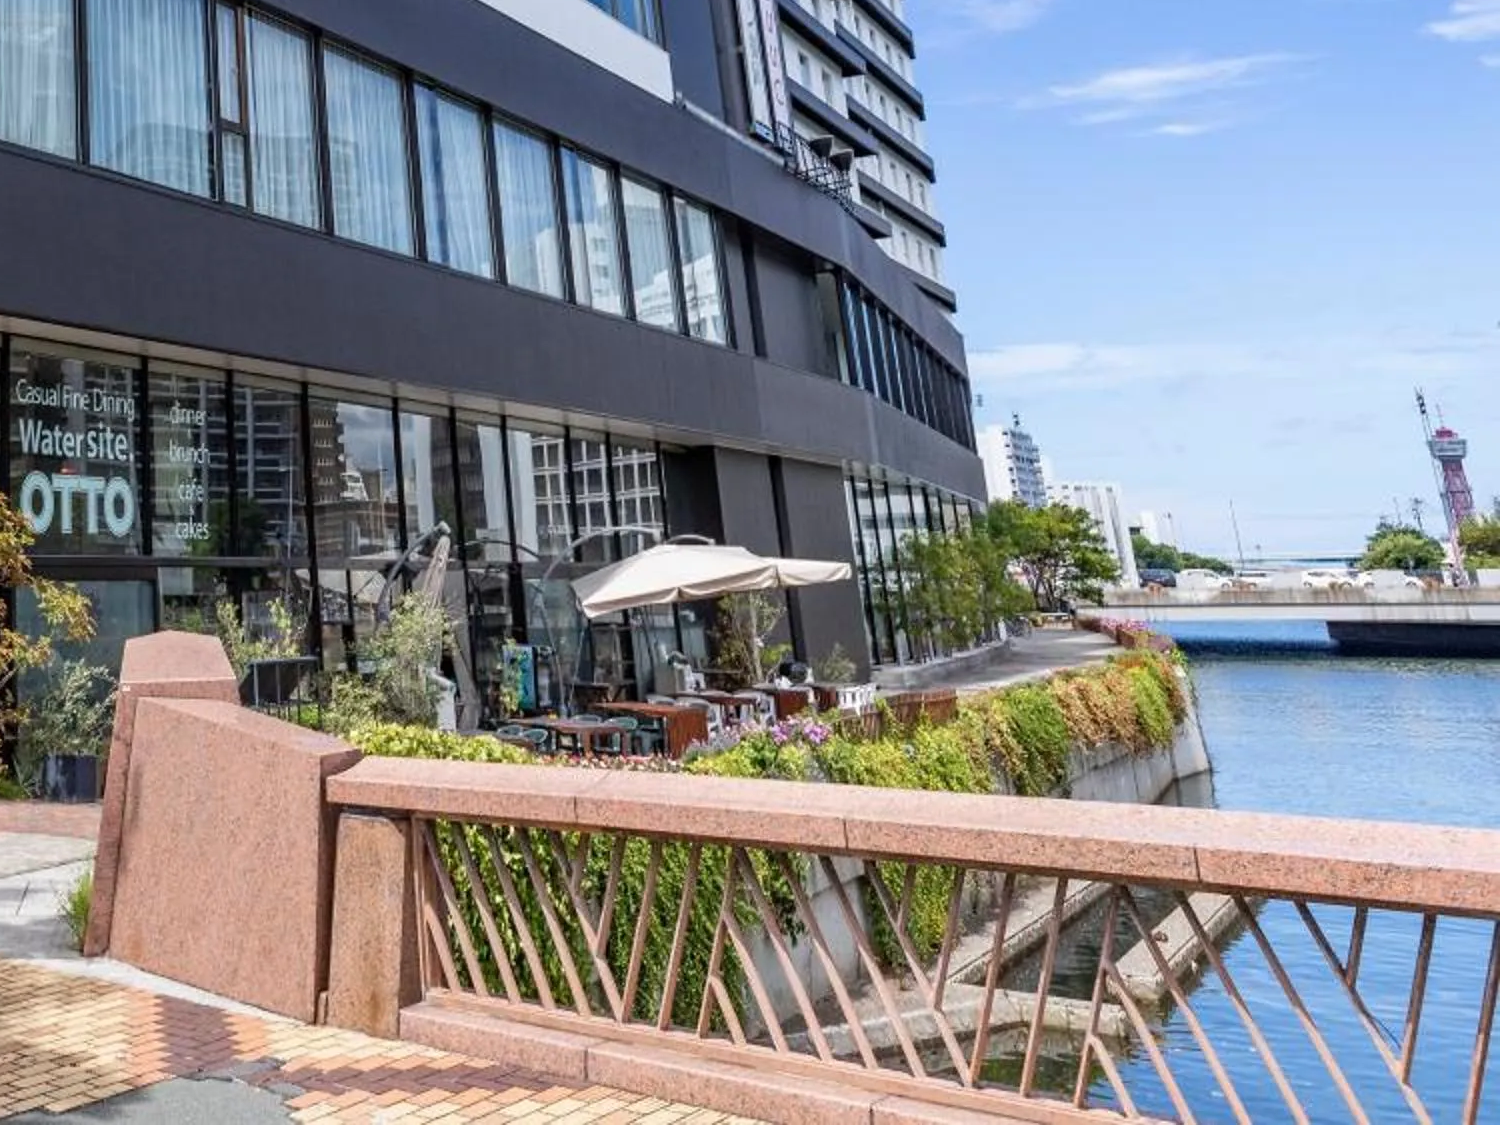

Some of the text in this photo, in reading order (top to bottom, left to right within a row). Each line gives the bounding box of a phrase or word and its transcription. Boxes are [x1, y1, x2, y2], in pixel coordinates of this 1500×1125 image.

[16, 379, 135, 422] Casual Fine Dining
[169, 400, 206, 426] dinner
[179, 478, 204, 502] cafe
[20, 470, 134, 537] OTTO
[176, 517, 210, 540] cakes
